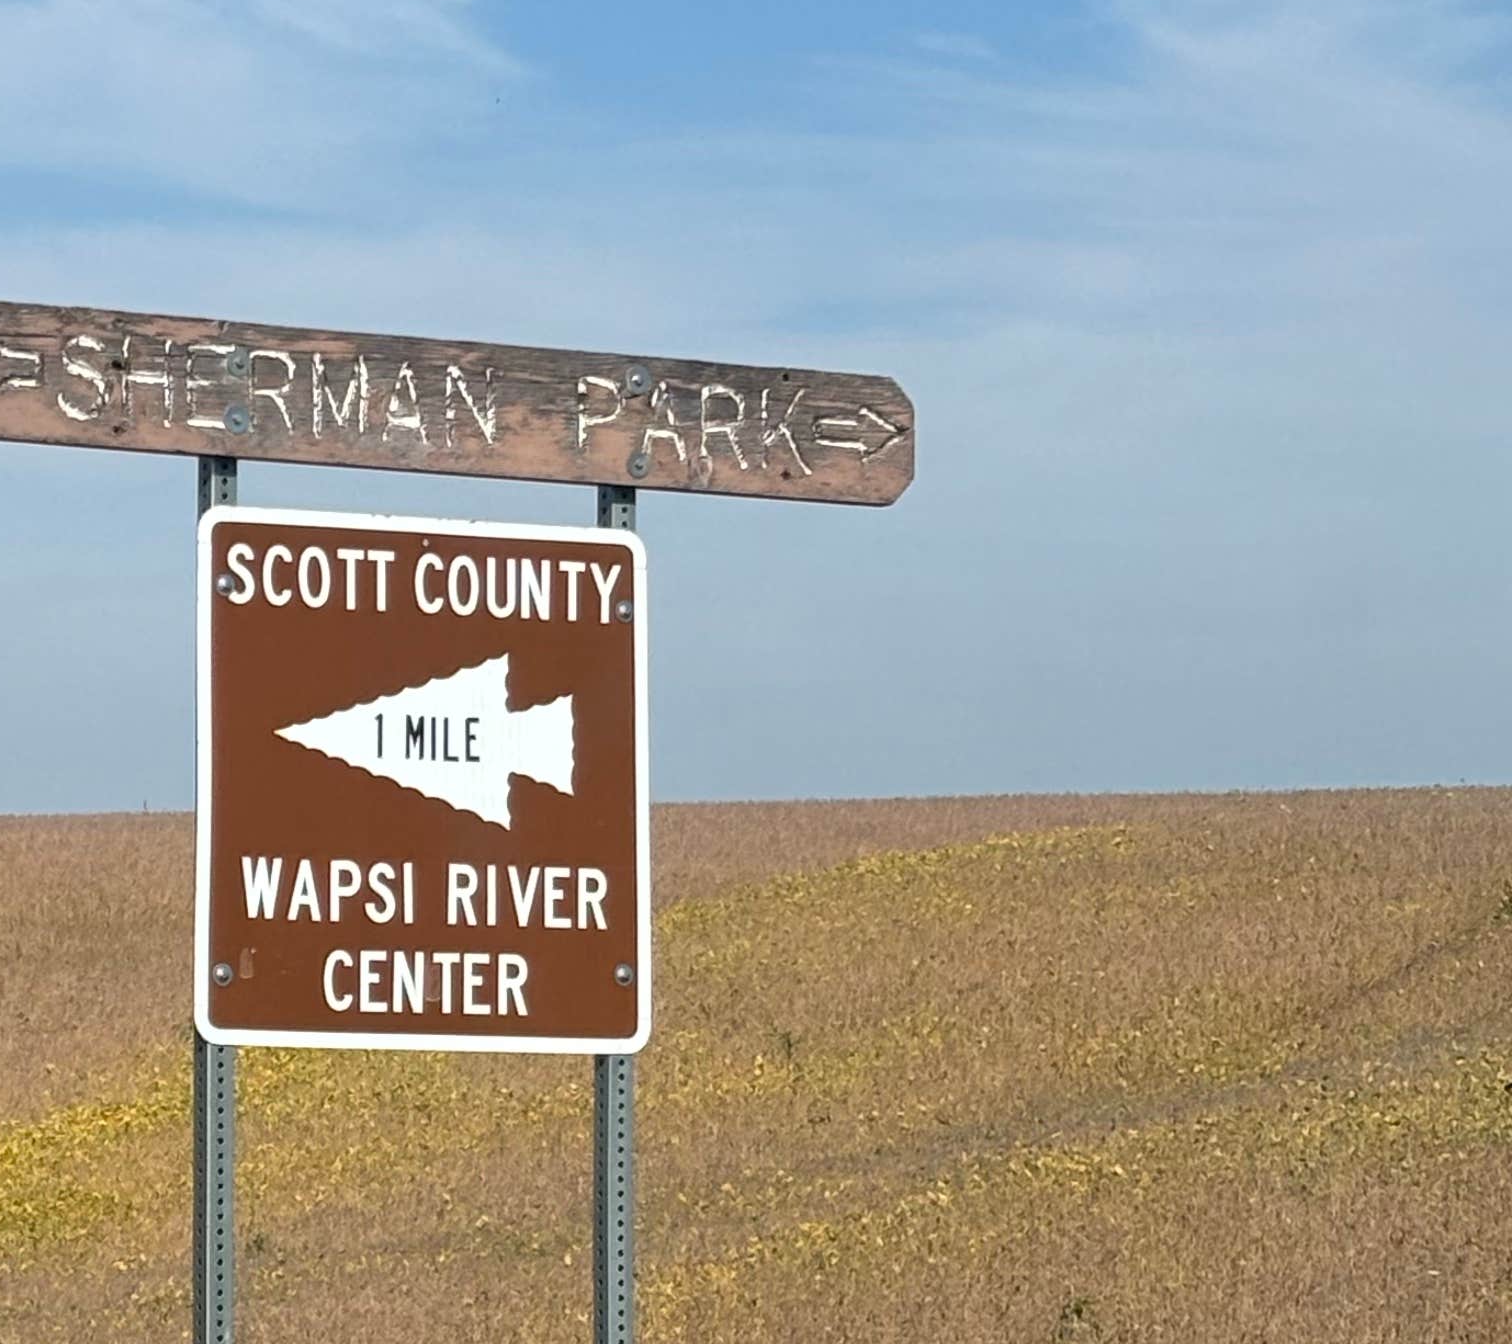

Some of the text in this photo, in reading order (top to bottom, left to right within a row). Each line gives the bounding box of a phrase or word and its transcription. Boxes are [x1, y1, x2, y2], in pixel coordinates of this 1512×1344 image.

[56, 334, 811, 475] SHERMAN PARK
[226, 543, 622, 624] SCOTT COUNTY
[374, 714, 481, 763] 1 MILE
[241, 856, 608, 931] WAPSI RIVER
[323, 949, 529, 1017] CENTER
